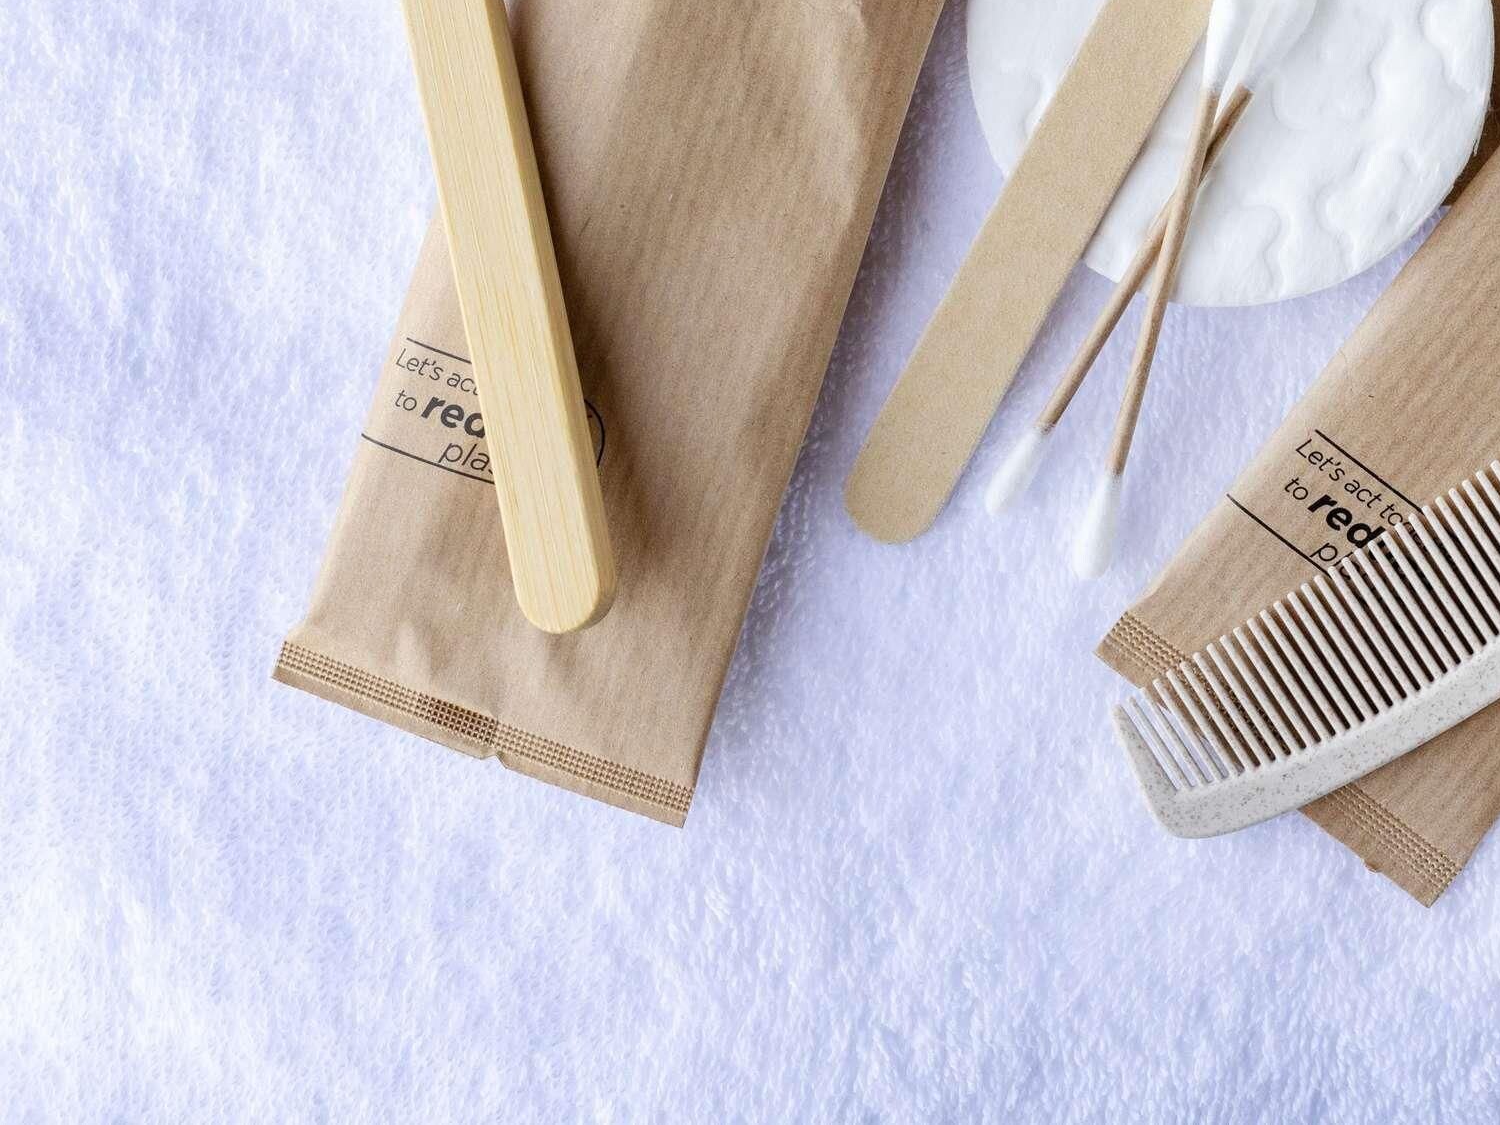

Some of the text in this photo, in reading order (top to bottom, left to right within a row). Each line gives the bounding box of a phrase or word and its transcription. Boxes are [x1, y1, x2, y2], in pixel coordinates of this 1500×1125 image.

[395, 347, 444, 381] Let's
[394, 389, 418, 412] to
[1295, 439, 1383, 508] Let's act
[1284, 476, 1309, 501] to
